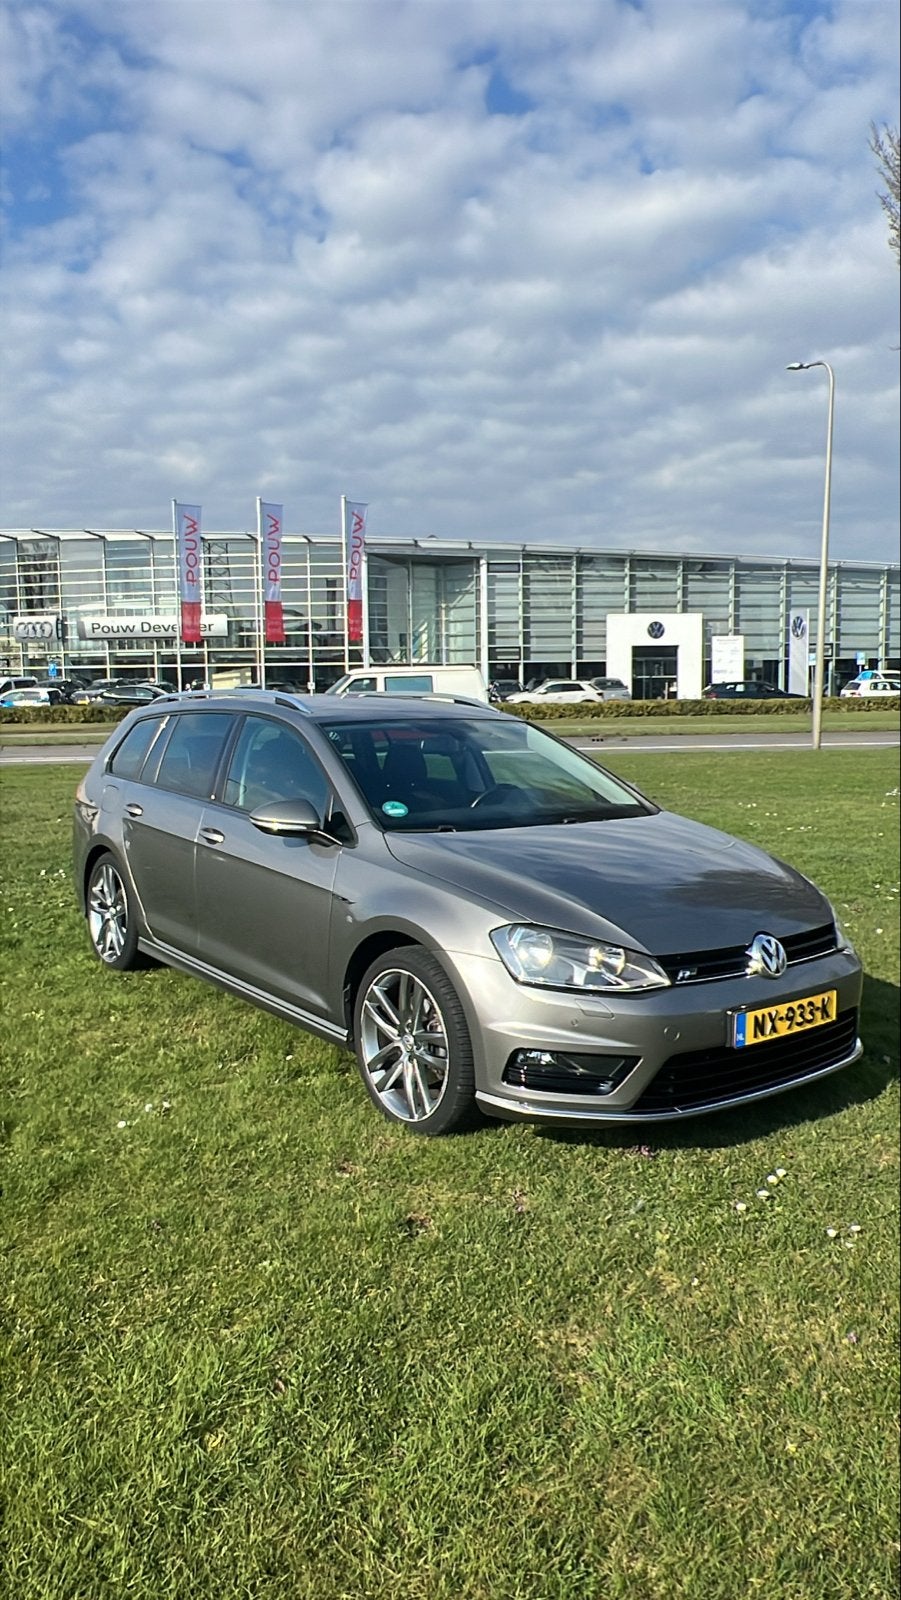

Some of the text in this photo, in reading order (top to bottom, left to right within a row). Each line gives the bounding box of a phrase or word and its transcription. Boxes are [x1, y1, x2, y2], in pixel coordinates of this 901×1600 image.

[184, 514, 198, 583] POUW
[266, 514, 280, 582] POUW
[350, 511, 364, 580] POUW
[91, 621, 215, 634] Pouw Deveer
[753, 996, 831, 1039] NX-933-K
